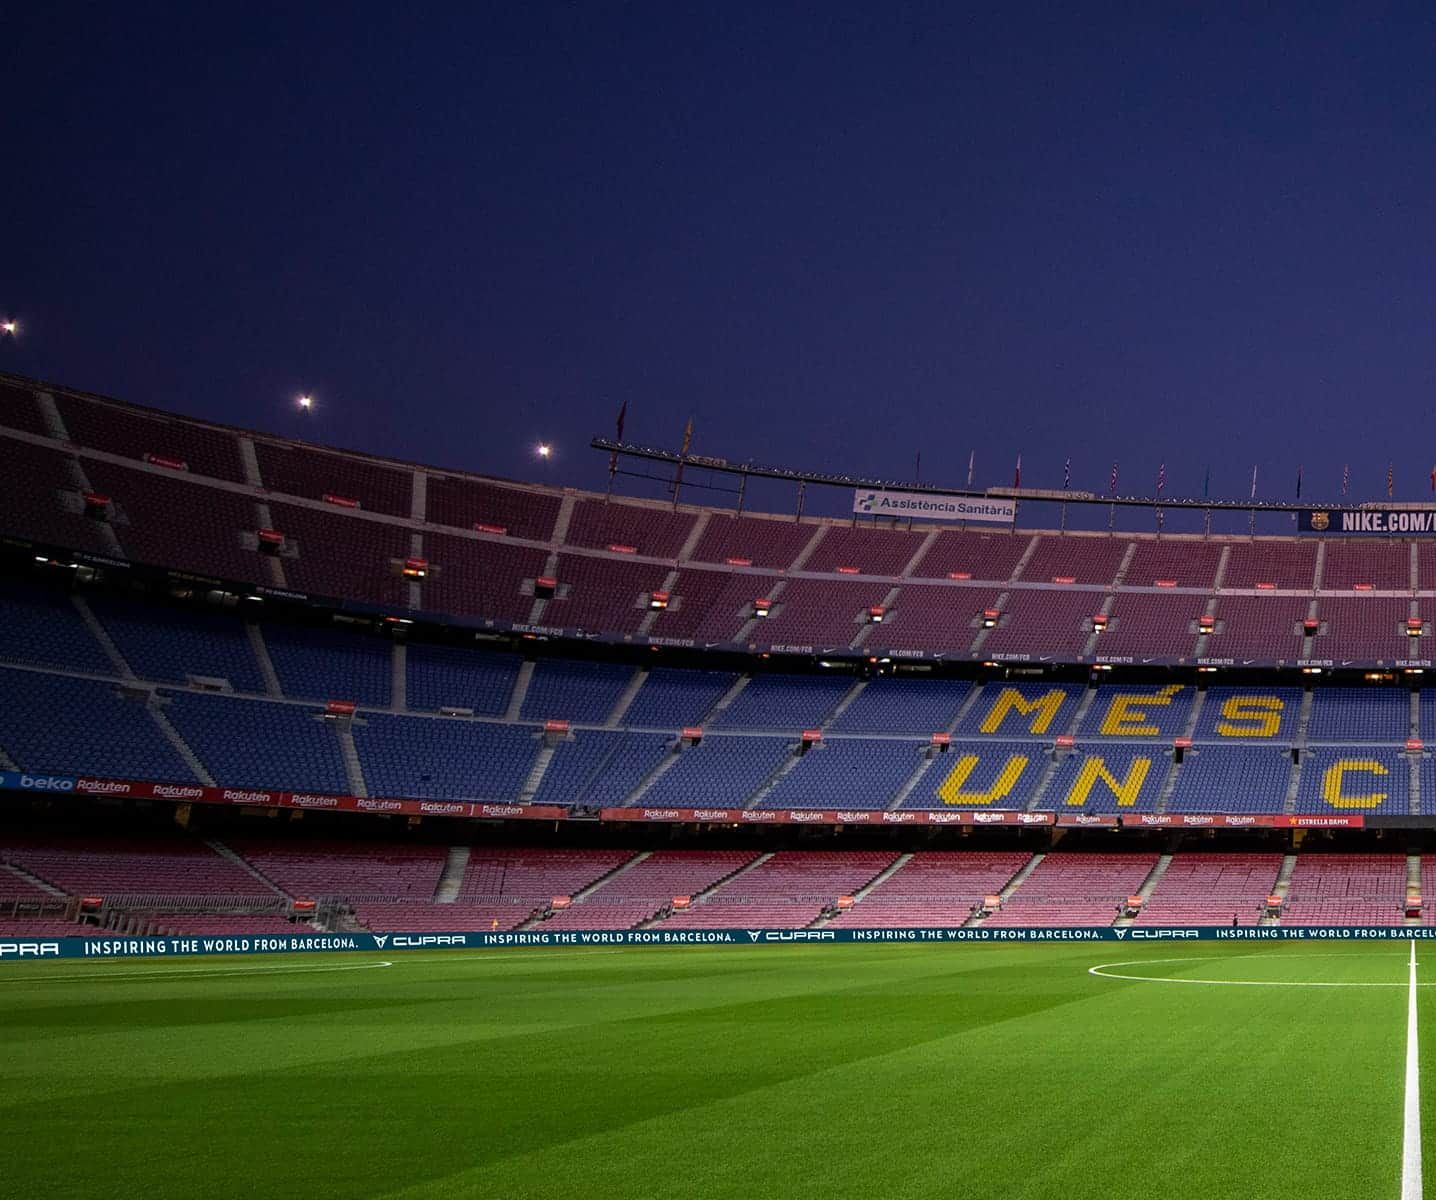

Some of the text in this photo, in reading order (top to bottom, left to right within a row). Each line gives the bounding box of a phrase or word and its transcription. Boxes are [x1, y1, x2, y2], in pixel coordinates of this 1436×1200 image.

[880, 497, 1013, 516] Assistència Sanitària
[981, 685, 1284, 738] MÉS
[20, 775, 73, 790] beko
[939, 757, 1150, 806] UN
[76, 780, 130, 794] Rakuten
[153, 784, 204, 798] Rakuten
[223, 790, 270, 802] Rakuten
[292, 794, 338, 806] Rakuten
[420, 802, 464, 814] Rakuten
[482, 804, 523, 816] Rakuten
[644, 810, 679, 820] Rakuten
[694, 810, 728, 820] Rakuten
[742, 810, 776, 820] Rakuten
[790, 811, 824, 820] Rakuten
[837, 812, 869, 822] Rakuten
[883, 812, 915, 822] Rakuten
[929, 813, 960, 822] Rakuten
[1142, 814, 1171, 824] Rakuten
[1184, 815, 1214, 824] Rakuten
[1226, 815, 1256, 824] Rakuten
[484, 932, 736, 945] INSPIRING THE WORLD FROM BARCELONA.
[765, 931, 835, 941] CUPRA
[852, 930, 1103, 940] INSPIRING THE WORLD FROM BARCELONA.
[1131, 929, 1199, 939] CUPRA
[1216, 929, 1278, 938] INSPIRING
[1281, 929, 1305, 938] THE
[1308, 929, 1351, 938] WORLD
[1354, 929, 1387, 938] FROM
[392, 935, 466, 946] CUPRA
[84, 937, 359, 955] INSPIRING THE WORLD FROM BARCELONA.
